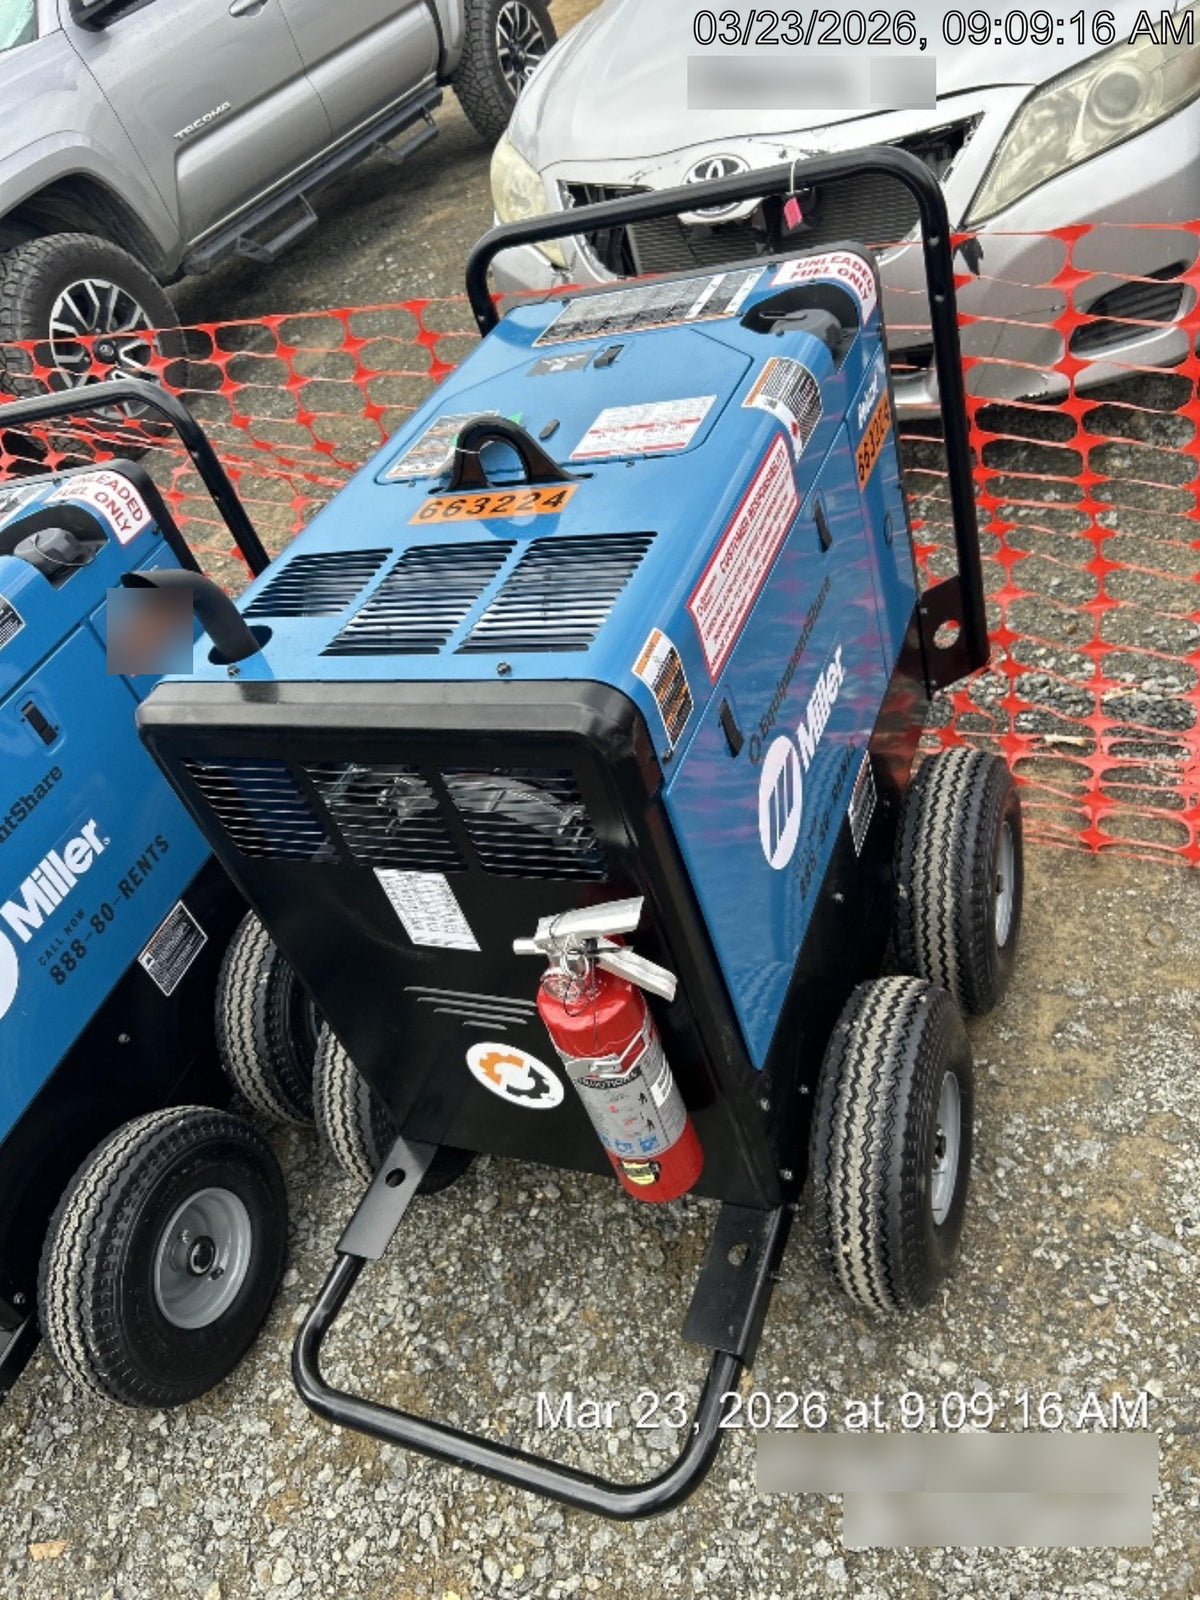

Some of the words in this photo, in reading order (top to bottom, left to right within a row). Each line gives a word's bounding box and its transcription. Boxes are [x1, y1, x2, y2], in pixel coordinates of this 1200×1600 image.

[173, 101, 231, 140] TACOMA
[790, 266, 831, 279] FUEL
[837, 267, 869, 300] ONLY
[796, 255, 874, 293] UNLEADED
[68, 473, 144, 523] UNLEADED
[94, 491, 133, 532] ONLY
[418, 490, 569, 521] 663224
[797, 643, 846, 773] Miller
[0, 817, 108, 944] Miller
[50, 834, 170, 986] 888-80-RENTS
[38, 937, 65, 967] CALL
[63, 907, 86, 935] NOW
